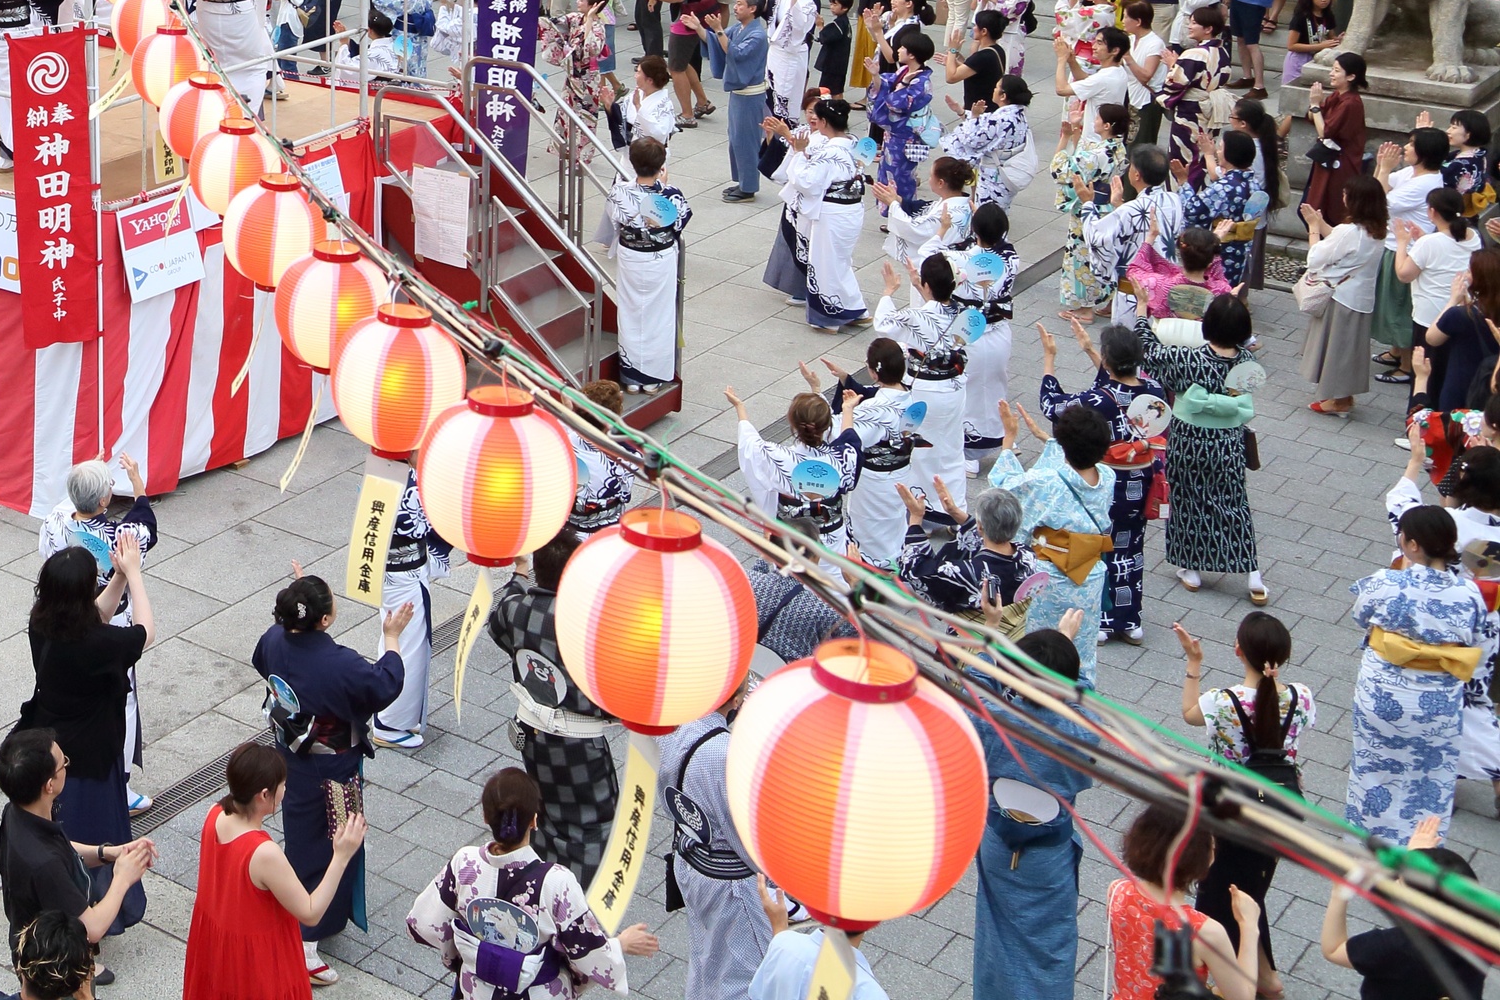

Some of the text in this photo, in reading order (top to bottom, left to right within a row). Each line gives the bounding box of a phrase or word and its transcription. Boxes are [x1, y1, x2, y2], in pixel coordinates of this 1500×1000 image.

[26, 101, 75, 129] 奉納
[33, 132, 75, 322] 神田明神 氏子中
[149, 251, 196, 274] COOL JAPAN TV
[167, 266, 182, 276] GROUP
[357, 500, 386, 593] 興産信用金庫
[601, 785, 646, 911] 興産信用金庫
